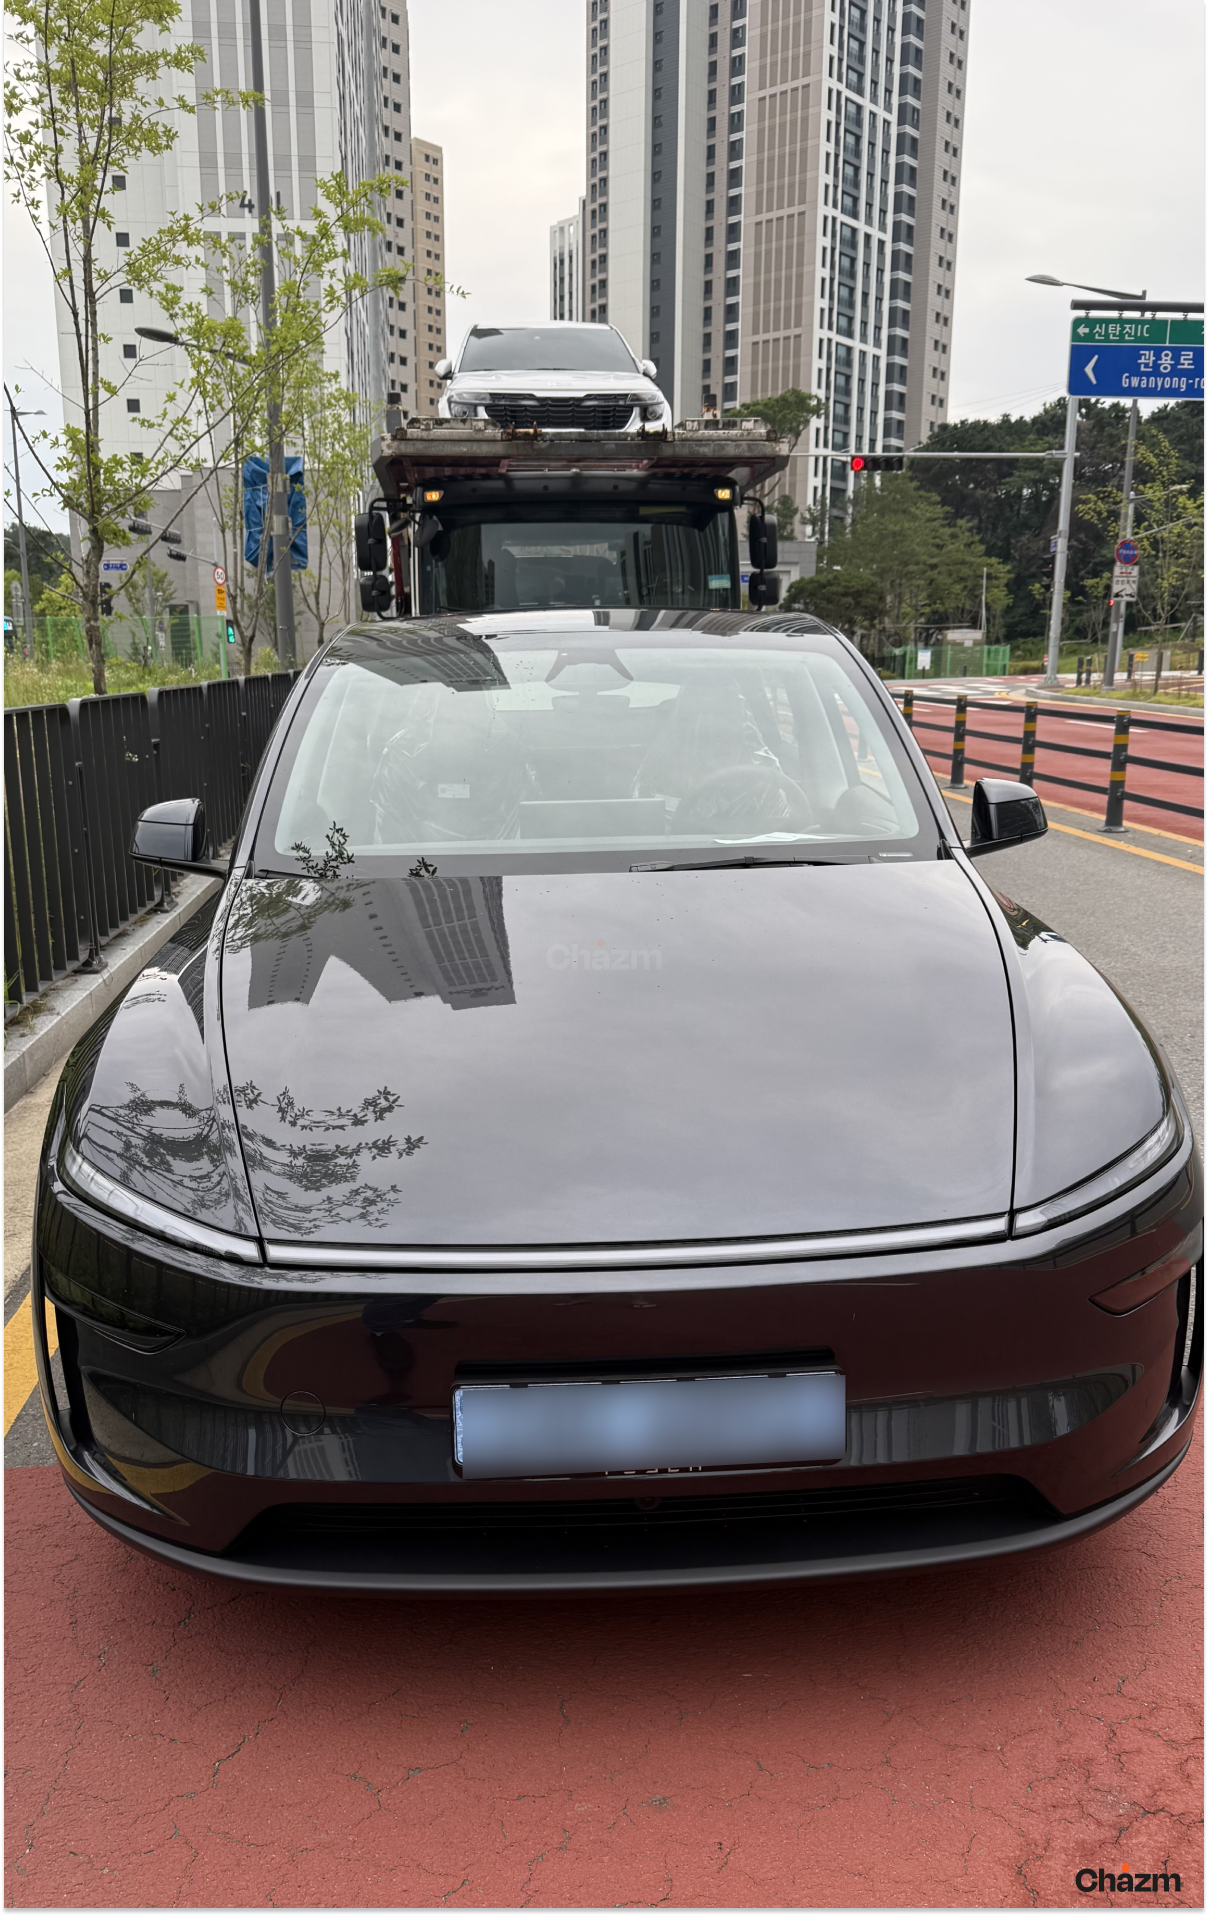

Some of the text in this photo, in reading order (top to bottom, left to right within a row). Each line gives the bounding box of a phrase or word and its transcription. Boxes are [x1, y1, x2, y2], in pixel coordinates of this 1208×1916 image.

[1093, 323, 1150, 340] 신탄진IC
[1137, 350, 1195, 374] 관용로
[216, 571, 225, 580] 50
